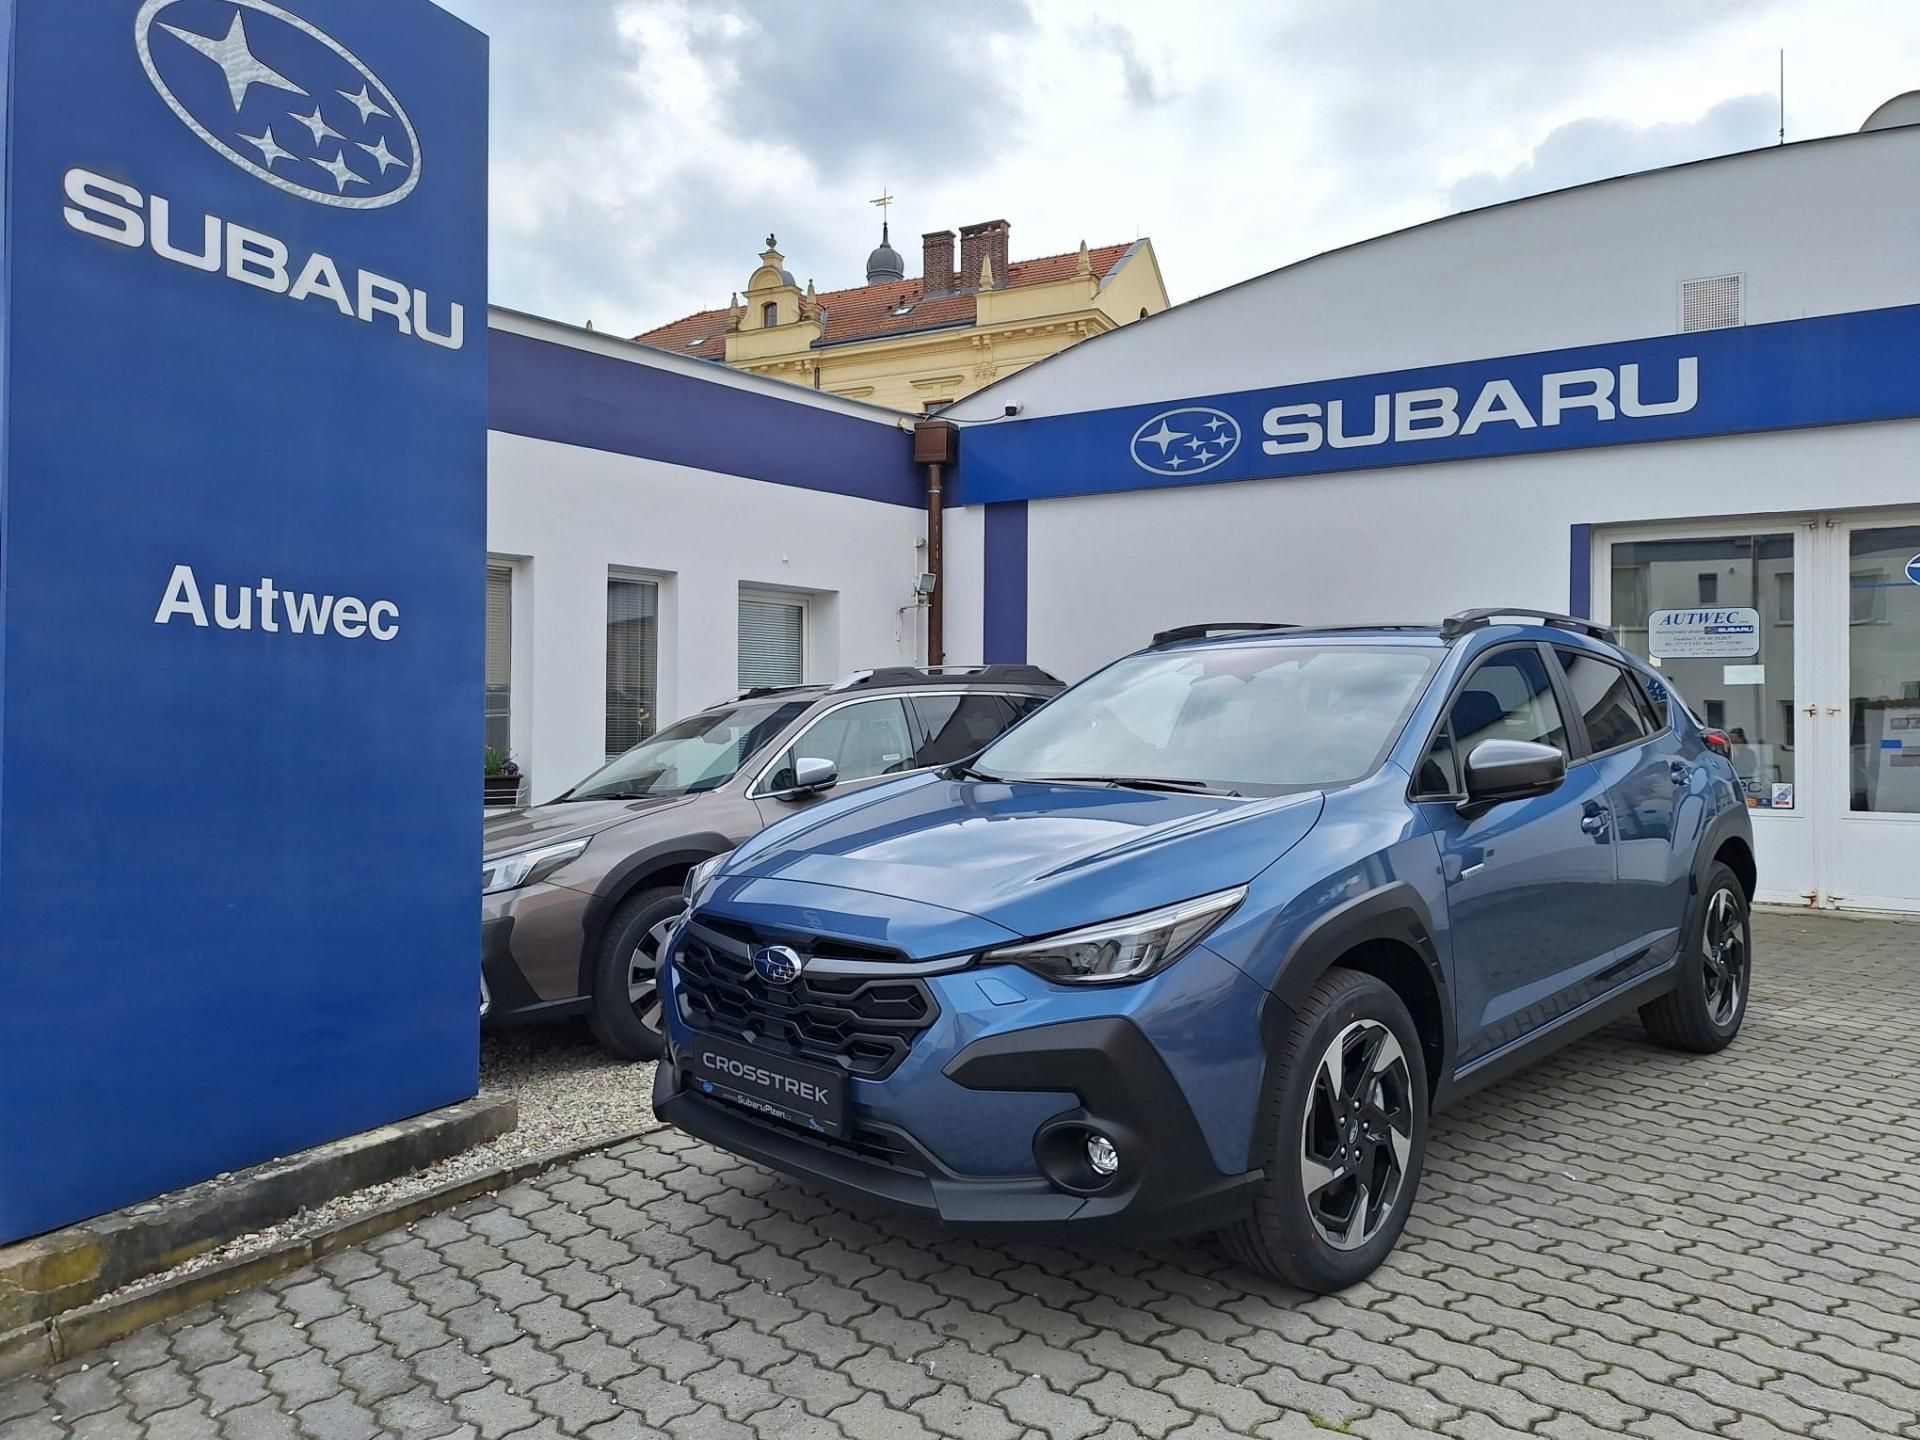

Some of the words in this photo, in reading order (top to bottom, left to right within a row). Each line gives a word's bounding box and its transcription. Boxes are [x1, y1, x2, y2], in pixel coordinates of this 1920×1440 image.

[63, 167, 465, 350] SUBARU
[1262, 356, 1699, 456] SUBARU
[153, 564, 400, 641] Autwec
[1659, 611, 1739, 625] AUTWEC
[702, 1051, 829, 1105] CROSSTREK
